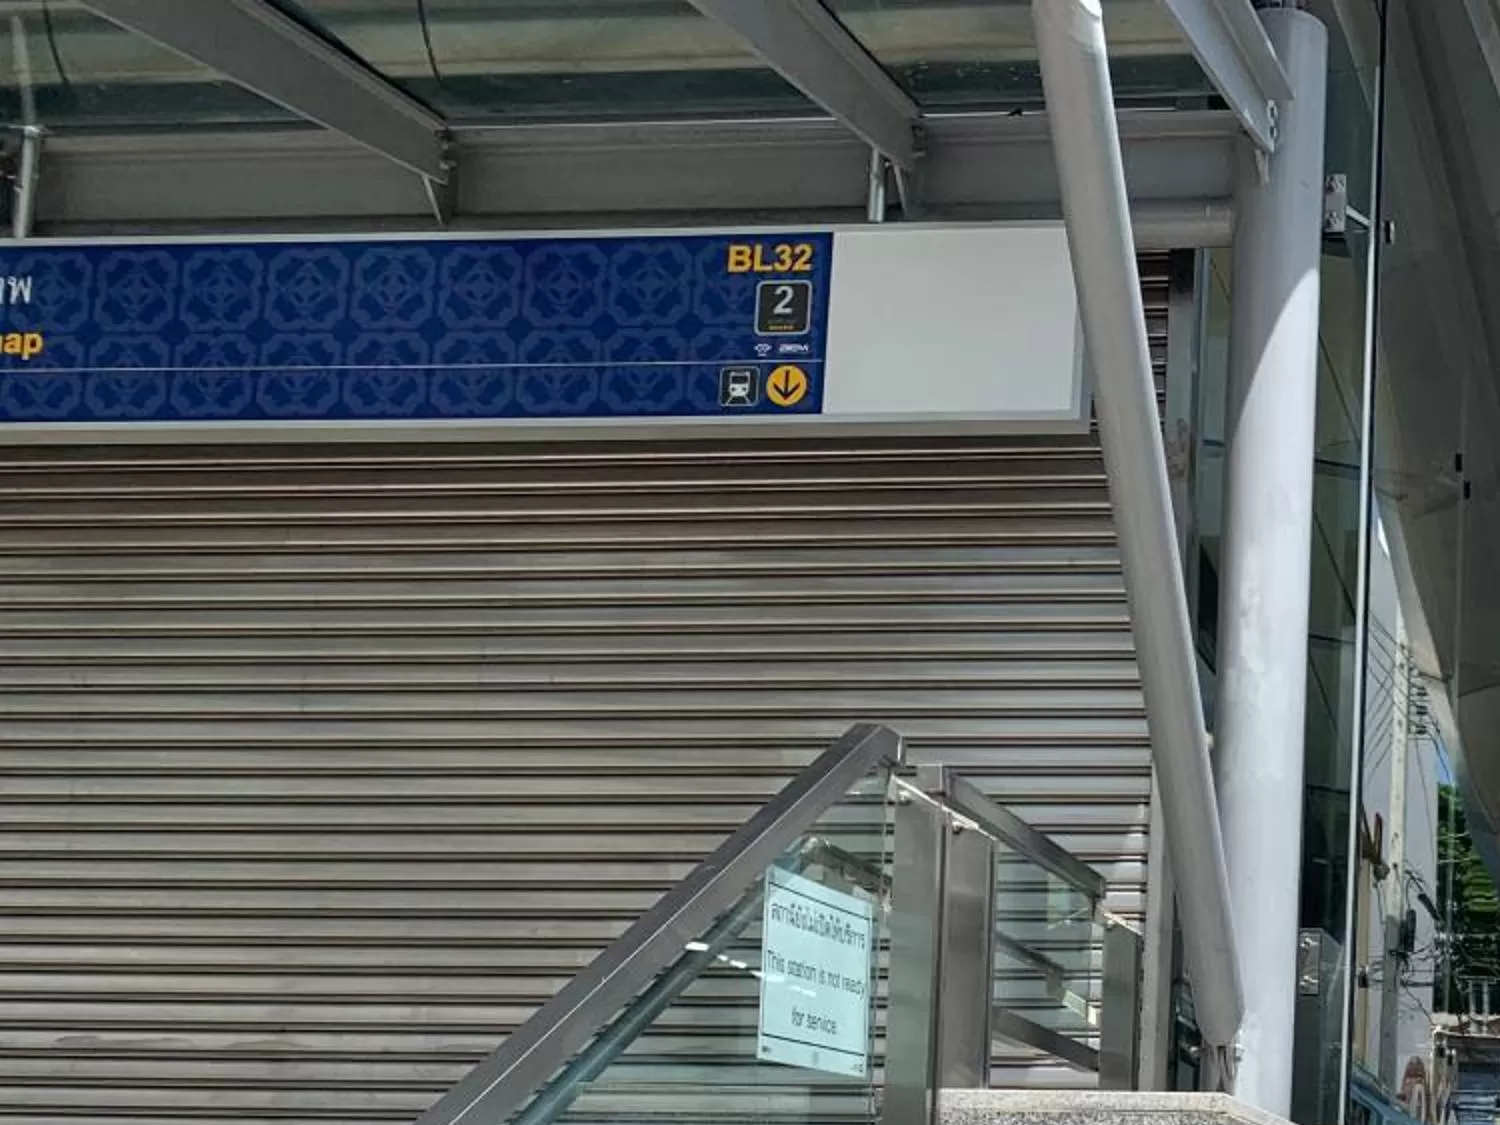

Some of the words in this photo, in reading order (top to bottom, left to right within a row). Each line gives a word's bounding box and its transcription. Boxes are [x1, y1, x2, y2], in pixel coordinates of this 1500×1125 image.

[727, 243, 814, 273] BL32
[773, 285, 794, 315] 2
[0, 332, 43, 360] ap
[767, 949, 785, 973] This
[787, 959, 817, 981] station
[828, 972, 841, 989] not
[842, 975, 865, 1001] ready
[791, 1004, 805, 1027] for
